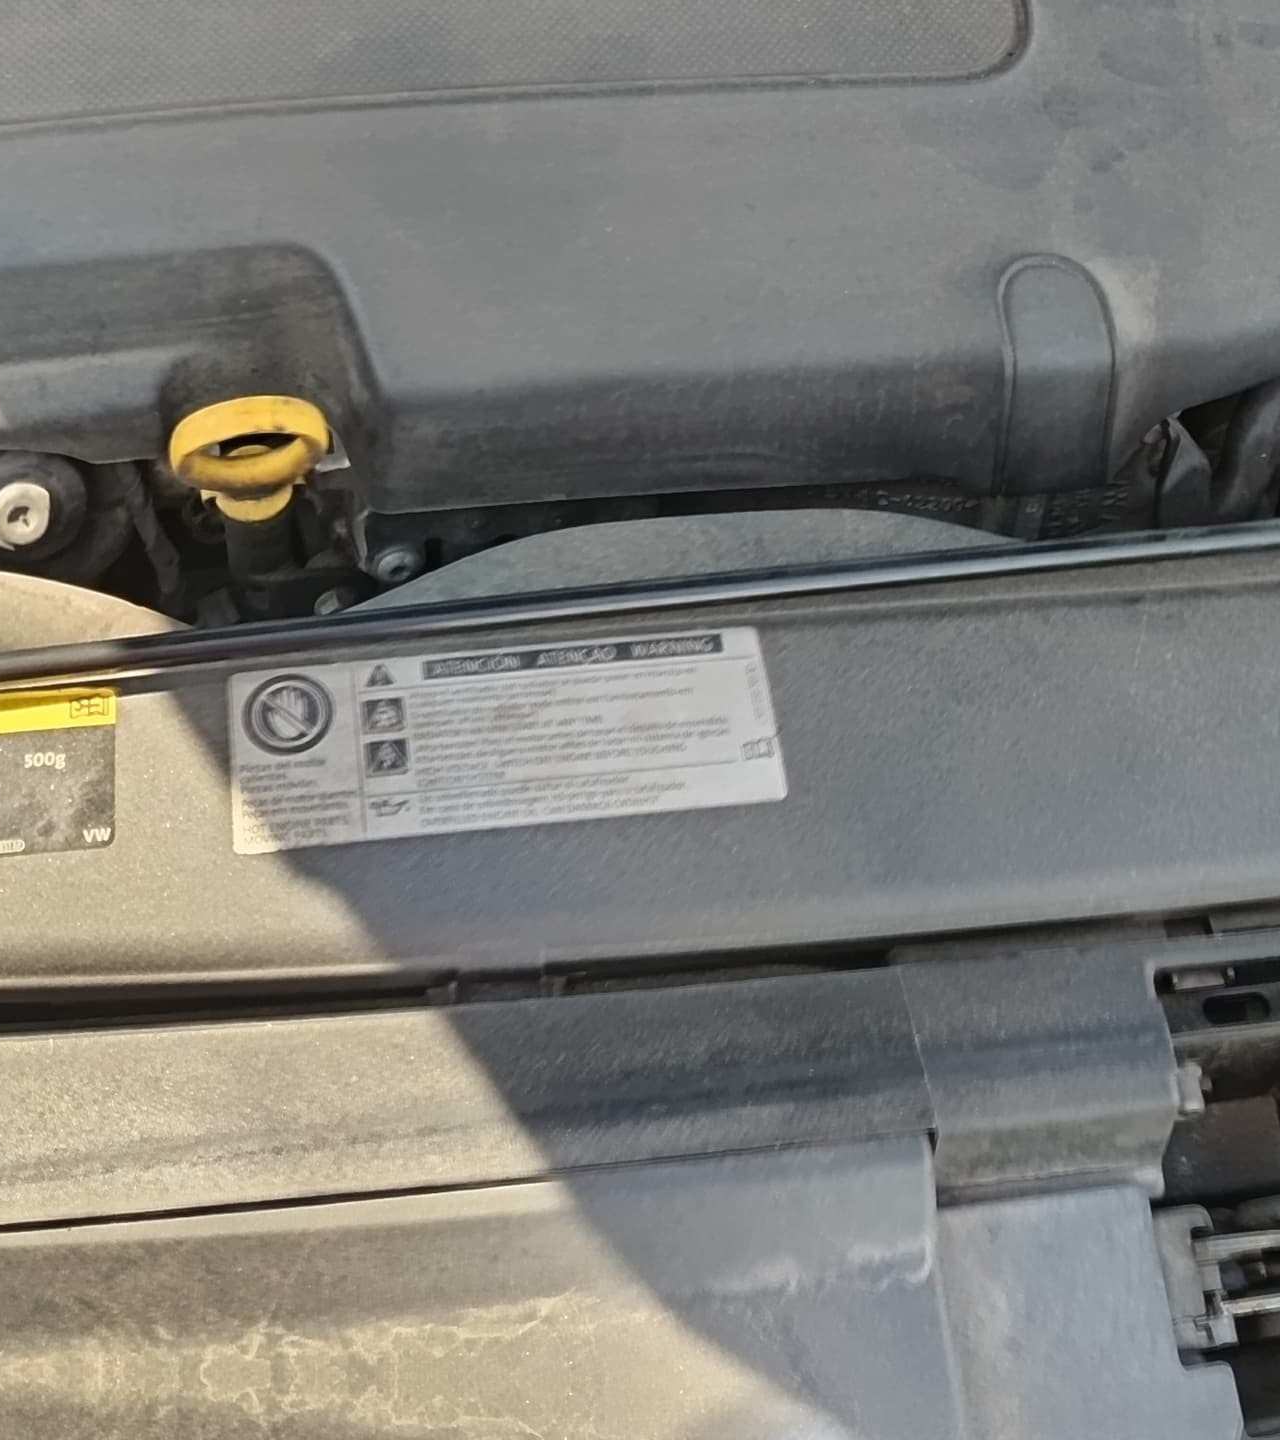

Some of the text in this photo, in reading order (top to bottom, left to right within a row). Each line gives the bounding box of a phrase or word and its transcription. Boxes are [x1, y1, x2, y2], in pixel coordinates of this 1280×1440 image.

[631, 636, 715, 658] WARNING
[24, 752, 67, 769] 500g
[83, 827, 111, 842] VW
